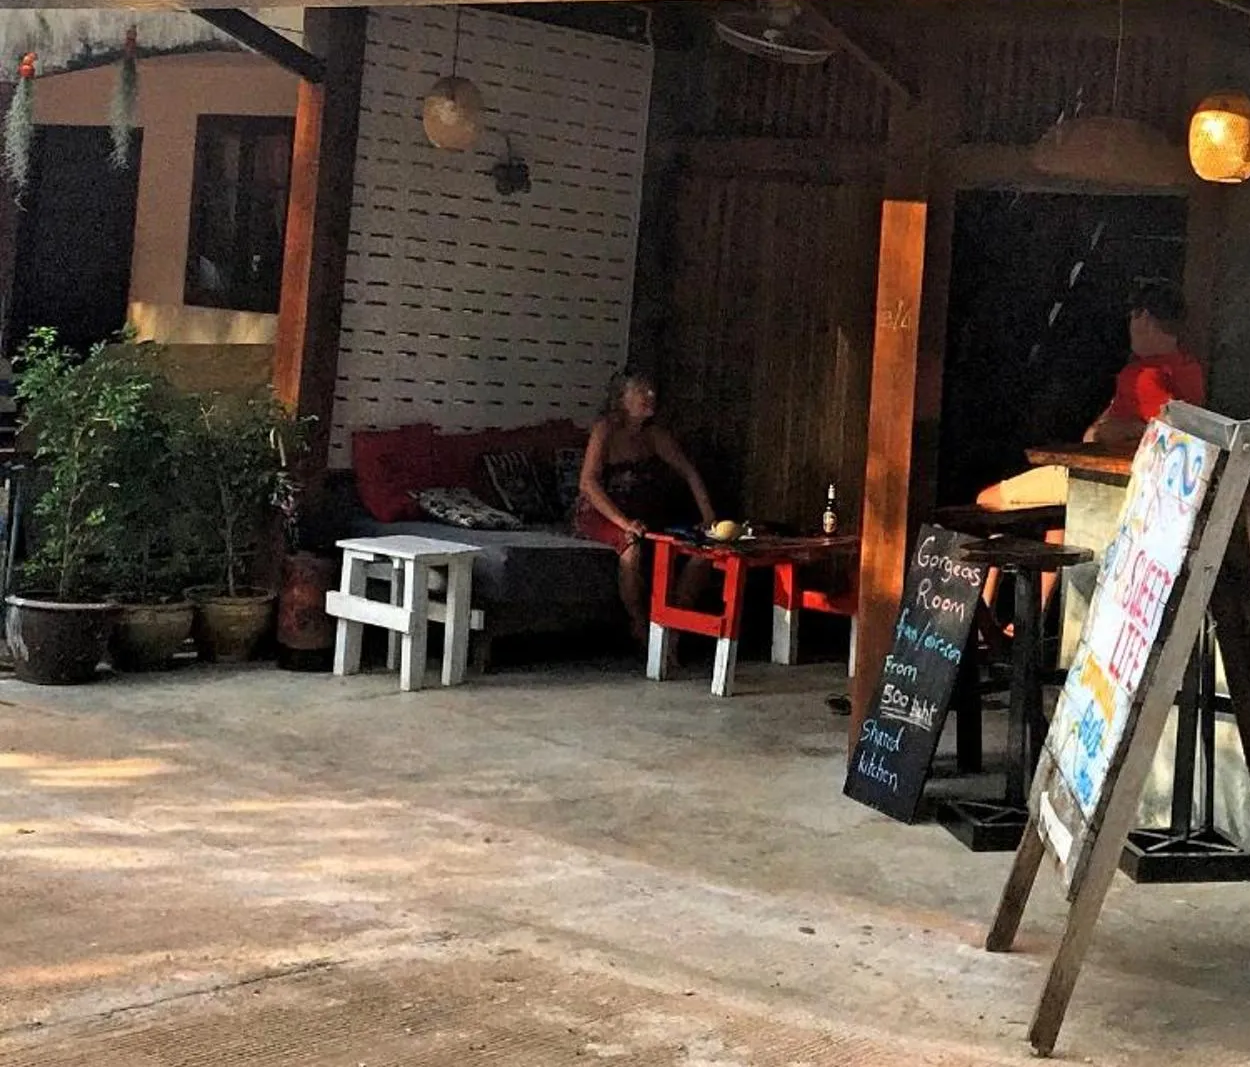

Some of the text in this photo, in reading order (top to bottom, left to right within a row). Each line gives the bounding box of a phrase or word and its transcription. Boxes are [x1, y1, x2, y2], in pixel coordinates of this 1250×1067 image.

[916, 578, 965, 623] Room
[884, 654, 918, 682] From
[1108, 618, 1148, 693] LIFE
[881, 683, 909, 707] 500
